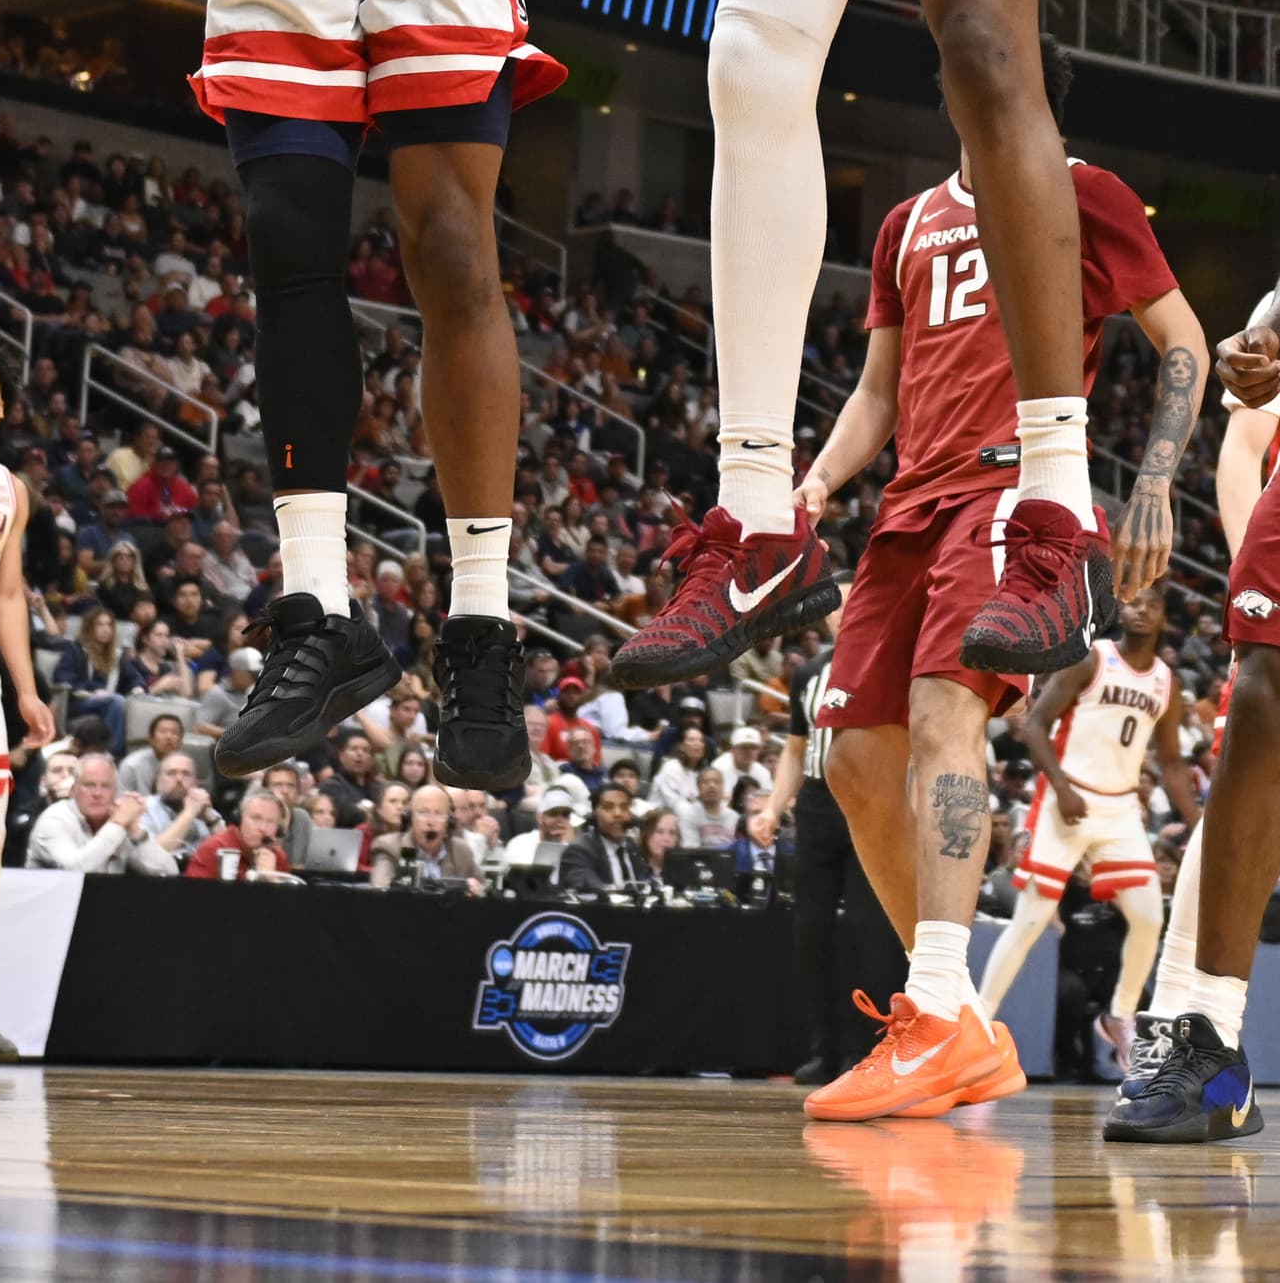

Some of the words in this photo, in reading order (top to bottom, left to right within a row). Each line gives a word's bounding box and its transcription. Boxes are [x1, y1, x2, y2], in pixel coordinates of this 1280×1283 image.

[928, 248, 989, 327] 12
[1120, 715, 1138, 748] 0
[513, 951, 591, 982] MARCH
[521, 982, 620, 1013] MADNESS
